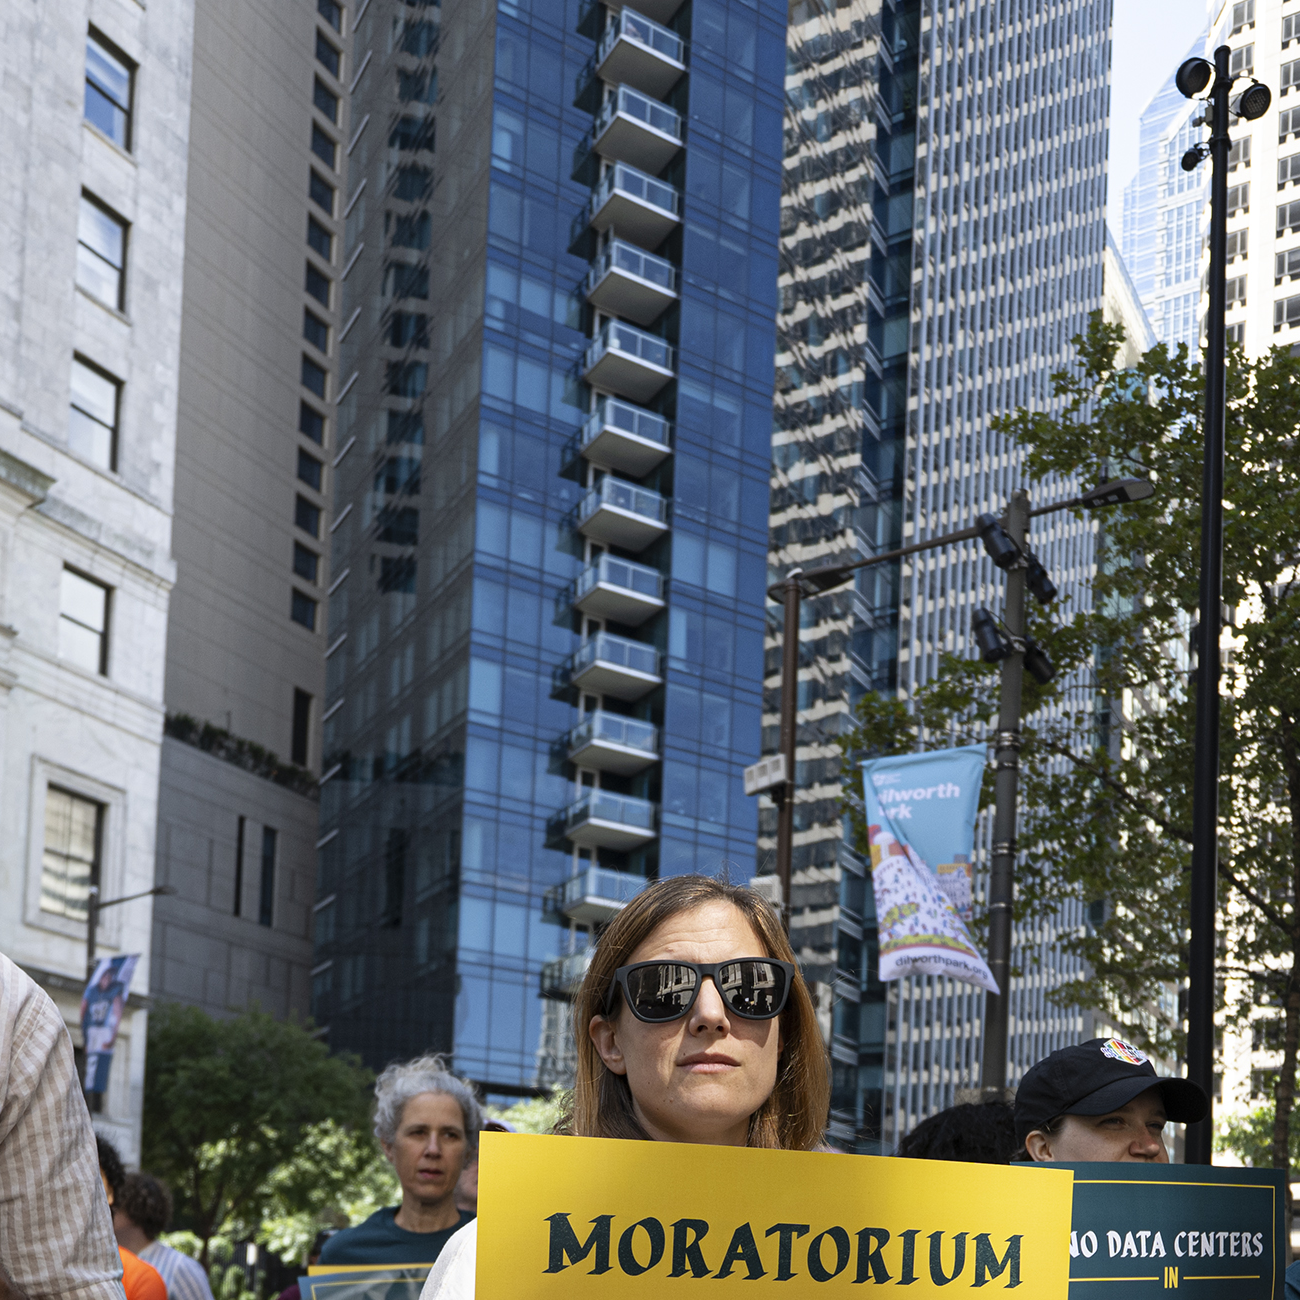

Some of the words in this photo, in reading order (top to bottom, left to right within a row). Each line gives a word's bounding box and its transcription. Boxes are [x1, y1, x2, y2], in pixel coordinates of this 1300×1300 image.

[878, 782, 960, 804] ilworth
[895, 954, 988, 979] dilworthpark.org
[543, 1212, 1025, 1290] MORATORIUM
[1106, 1230, 1167, 1258] DATA
[1173, 1230, 1264, 1258] CENTERS
[1163, 1266, 1179, 1289] IN
